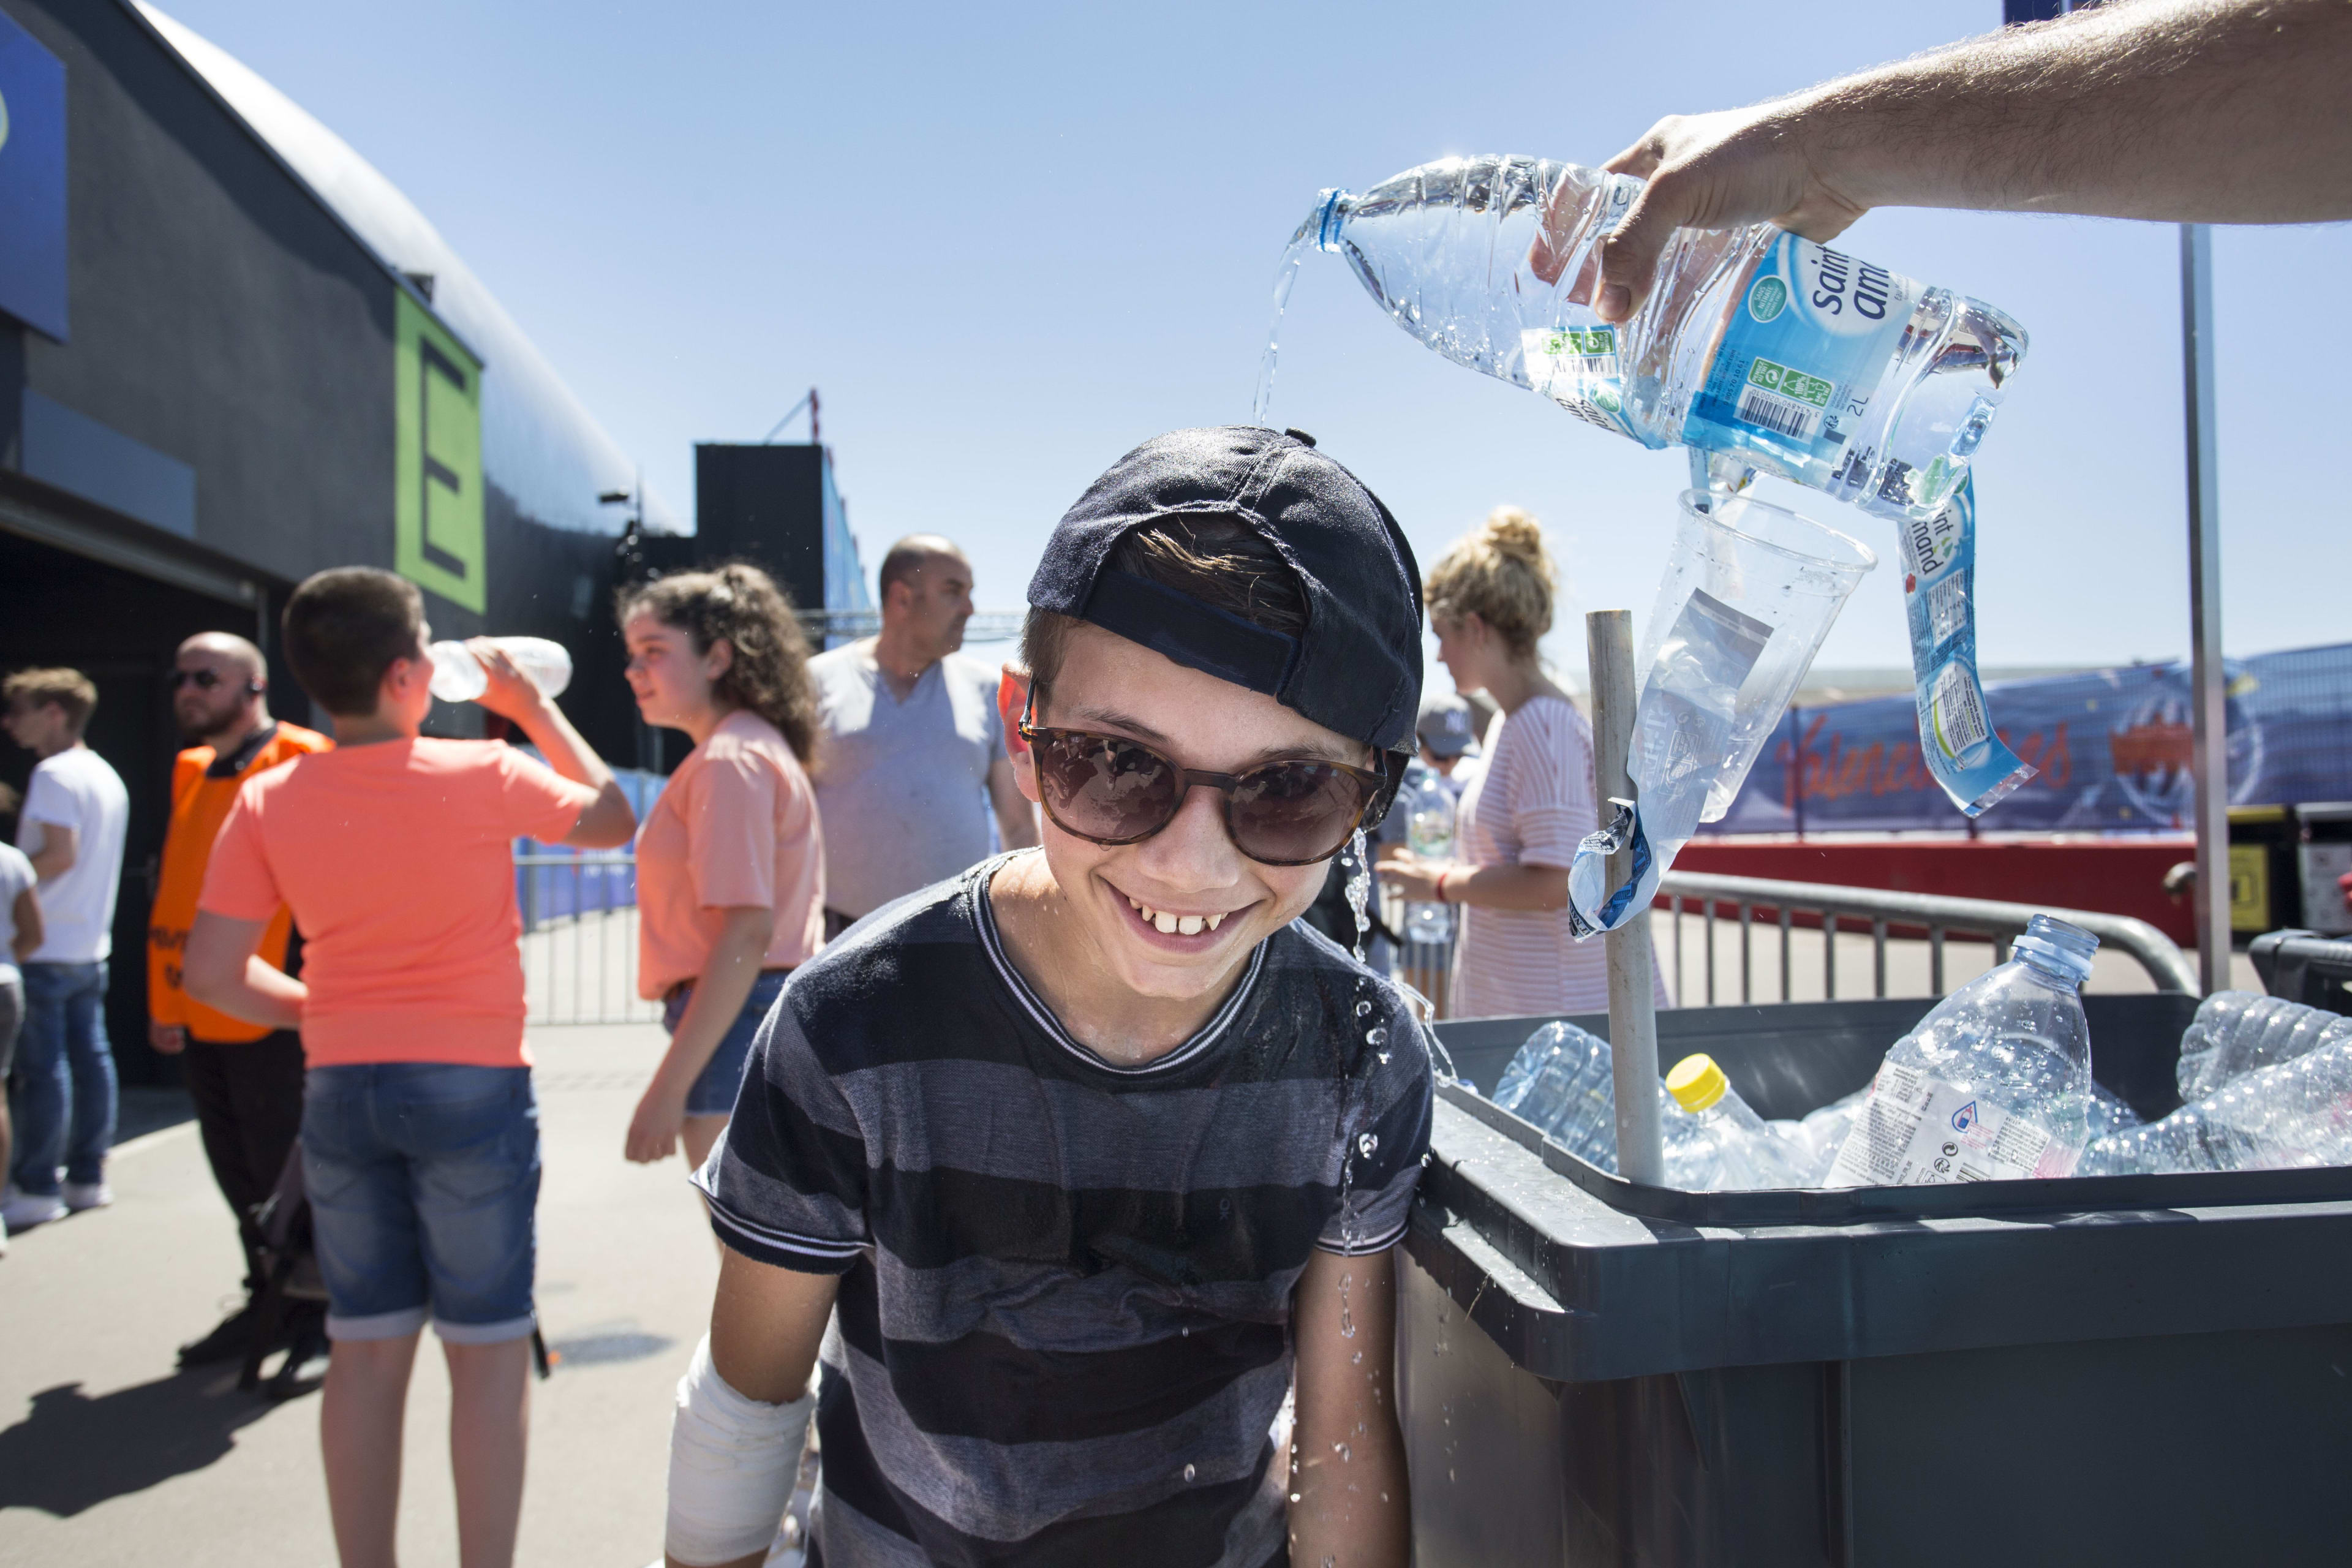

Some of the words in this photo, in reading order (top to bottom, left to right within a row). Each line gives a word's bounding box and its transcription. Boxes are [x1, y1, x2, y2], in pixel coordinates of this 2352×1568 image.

[1754, 285, 1766, 301] SANS
[1736, 358, 1745, 369] 61
[1751, 360, 1764, 382] PENSEZ
[1733, 368, 1741, 378] 10
[1729, 378, 1737, 388] 70
[1795, 376, 1806, 394] 100%
[1814, 391, 1822, 402] BAC
[421, 334, 466, 579] E
[1933, 510, 1955, 535] int
[1911, 521, 1943, 574] mand
